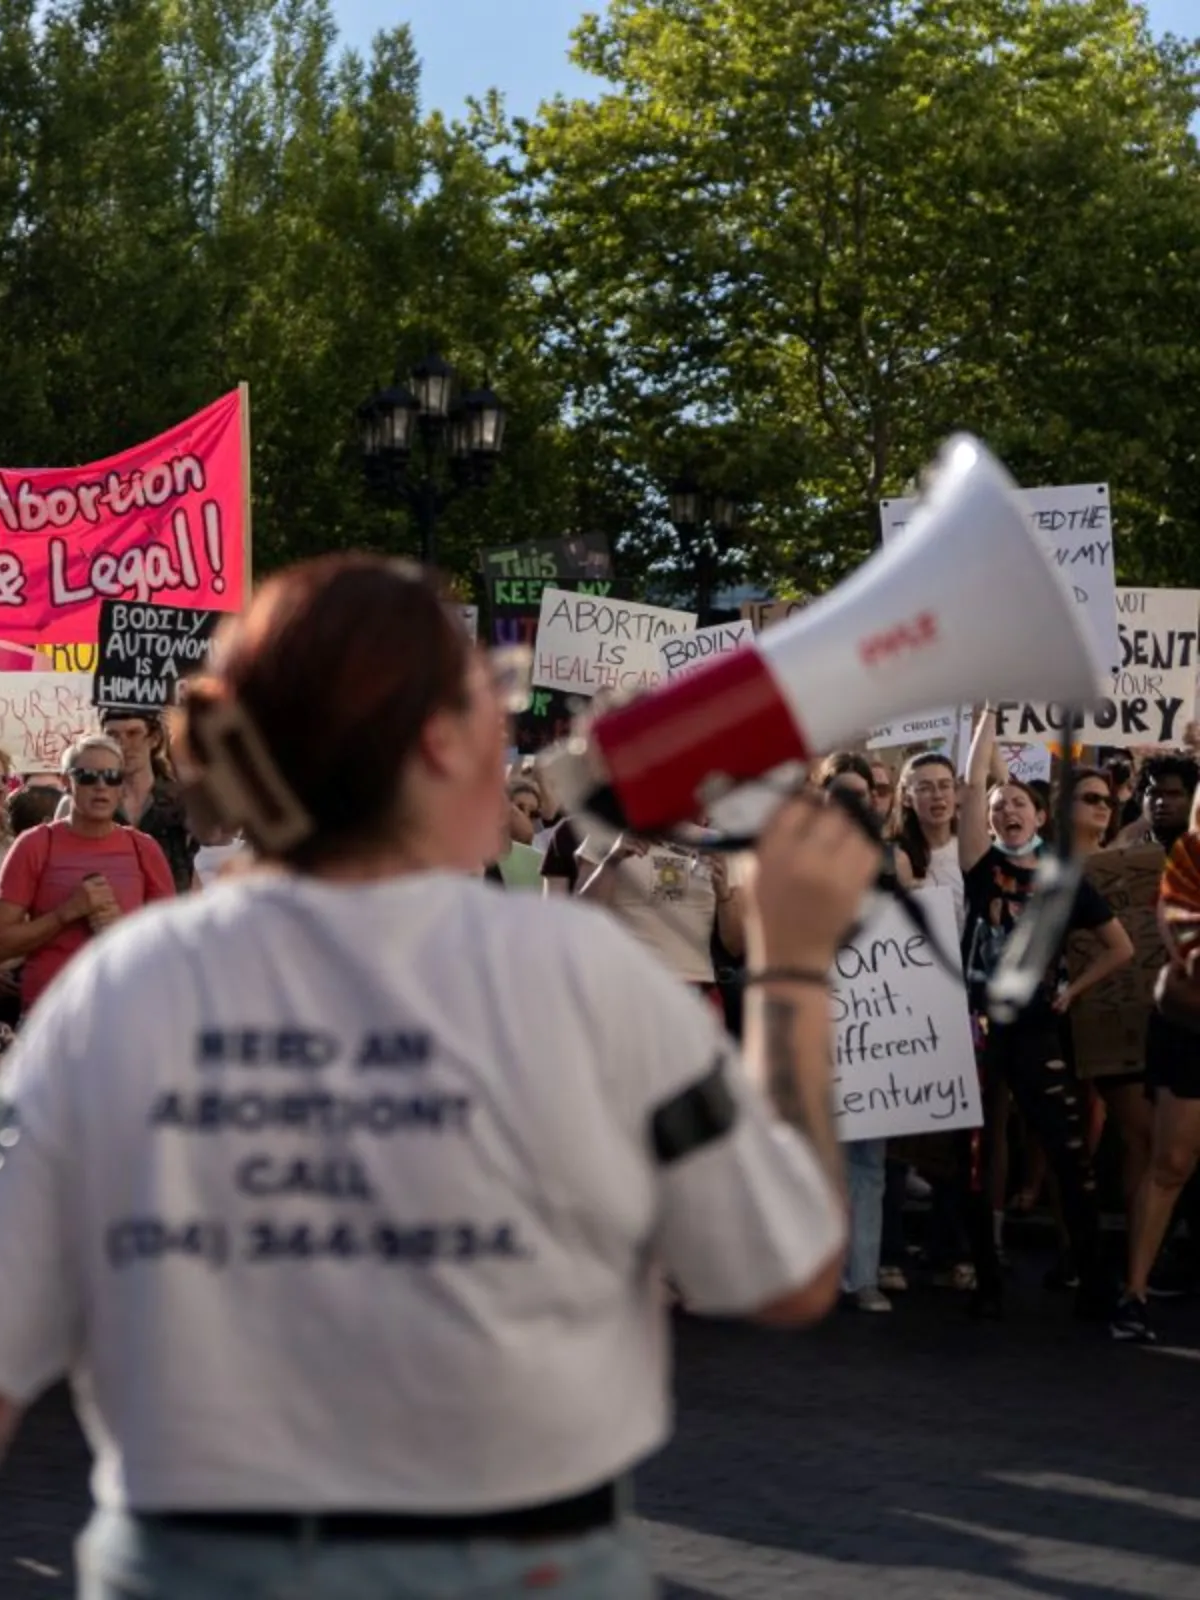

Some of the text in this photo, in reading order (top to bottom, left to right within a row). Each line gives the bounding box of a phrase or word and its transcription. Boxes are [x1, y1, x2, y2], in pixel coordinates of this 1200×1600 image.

[1071, 541, 1111, 567] MY
[495, 580, 559, 604] KEE
[112, 604, 209, 636] BODILY
[106, 631, 216, 661] AUTONOM
[597, 641, 627, 665] IS
[660, 626, 746, 669] BODILY
[135, 656, 178, 679] IS A
[538, 652, 662, 691] HEALTHCAR
[99, 675, 167, 703] HUMAN
[1112, 672, 1164, 699] YOUR
[836, 935, 934, 979] ame
[835, 1015, 940, 1065] ifferent
[236, 1154, 374, 1200] CALL
